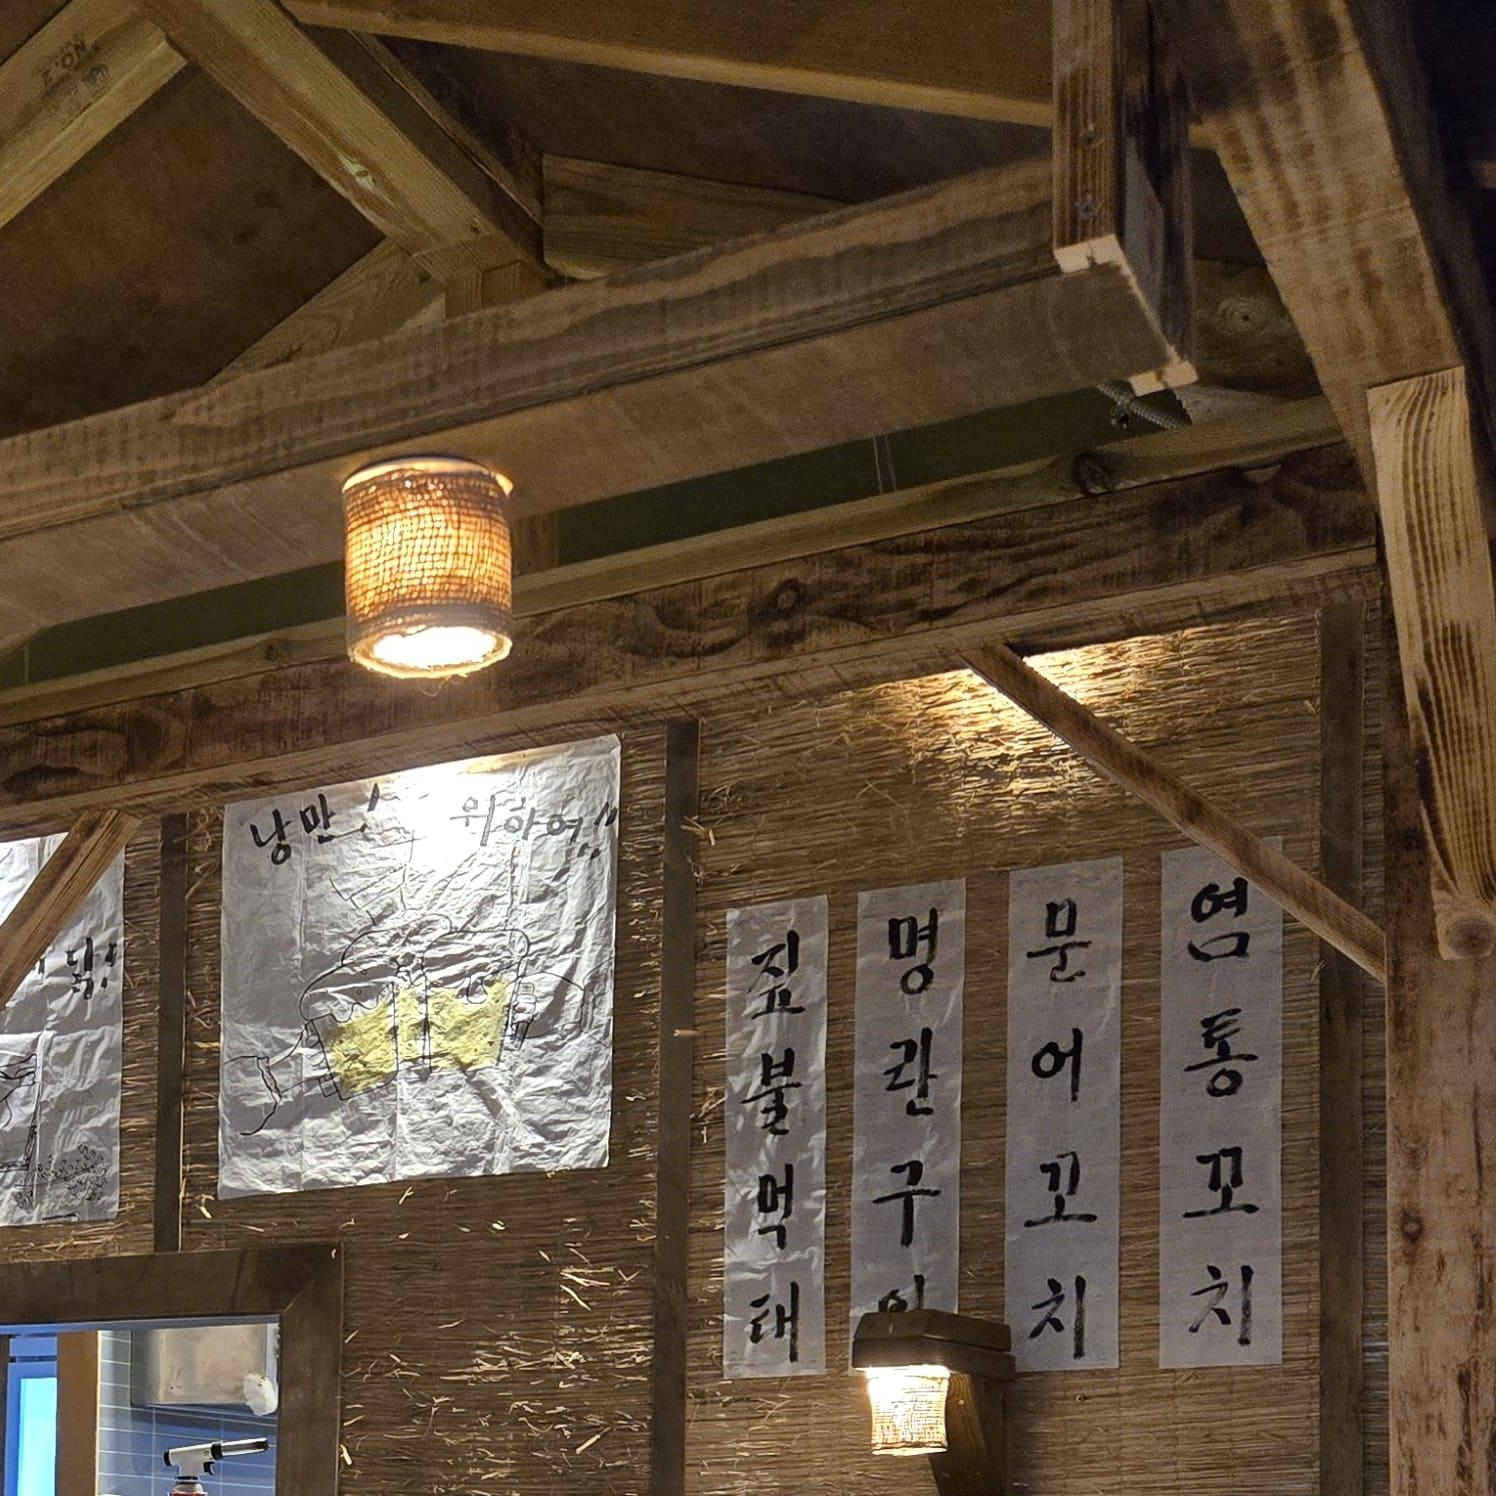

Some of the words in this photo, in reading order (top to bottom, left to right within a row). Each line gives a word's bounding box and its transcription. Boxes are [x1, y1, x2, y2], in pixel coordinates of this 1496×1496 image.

[250, 783, 380, 865] 낭만
[740, 930, 805, 1362] 짚불먹태
[1024, 898, 1098, 1360] 문어꼬치
[1183, 877, 1260, 1347] 염통꼬치
